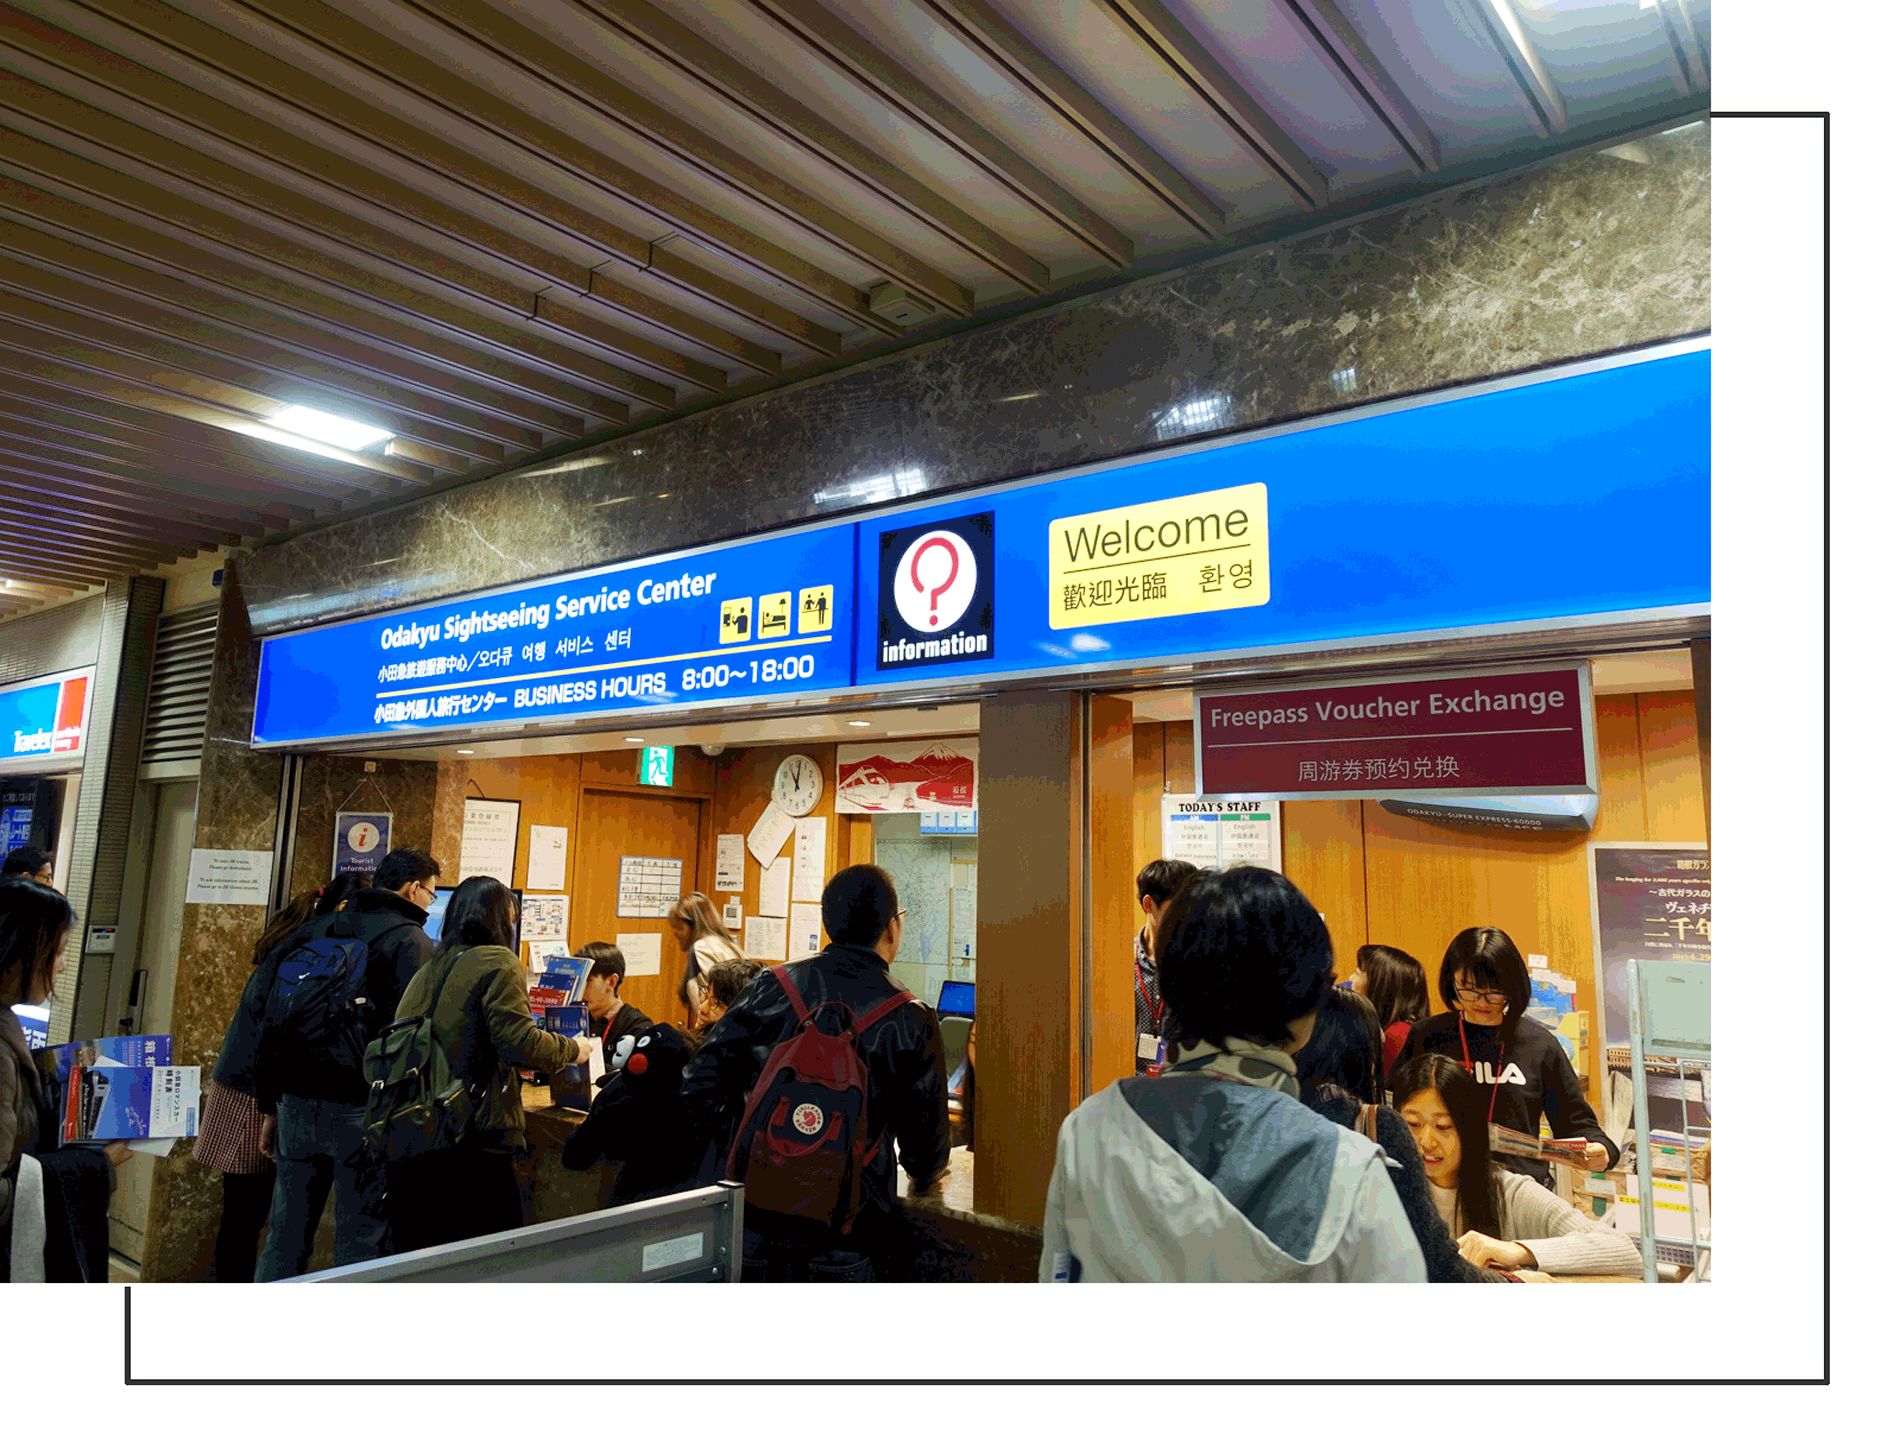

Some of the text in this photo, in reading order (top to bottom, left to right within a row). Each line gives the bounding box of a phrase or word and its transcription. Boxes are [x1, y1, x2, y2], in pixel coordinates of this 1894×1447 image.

[1065, 509, 1248, 563] Welcome
[1063, 560, 1252, 611] 歡迎光臨 환영
[380, 572, 717, 650] Odakyu Sightseeing Service Center
[522, 641, 546, 662] 여행
[555, 635, 594, 657] 서비스
[604, 628, 631, 650] 센터
[882, 631, 988, 663] information
[514, 675, 597, 709] BUSINESS
[601, 672, 667, 697] HOURS
[1211, 689, 1565, 730] Freepass Voucher Exchange
[1298, 755, 1460, 782] 周游券预约兑换
[1178, 801, 1262, 812] TODAY'S STAFF
[350, 856, 374, 864] Tourist
[1676, 860, 1709, 870] 箱根ガラ
[1643, 917, 1711, 941] 二千年
[164, 1069, 173, 1094] 時刻表
[1475, 1061, 1527, 1085] ILA
